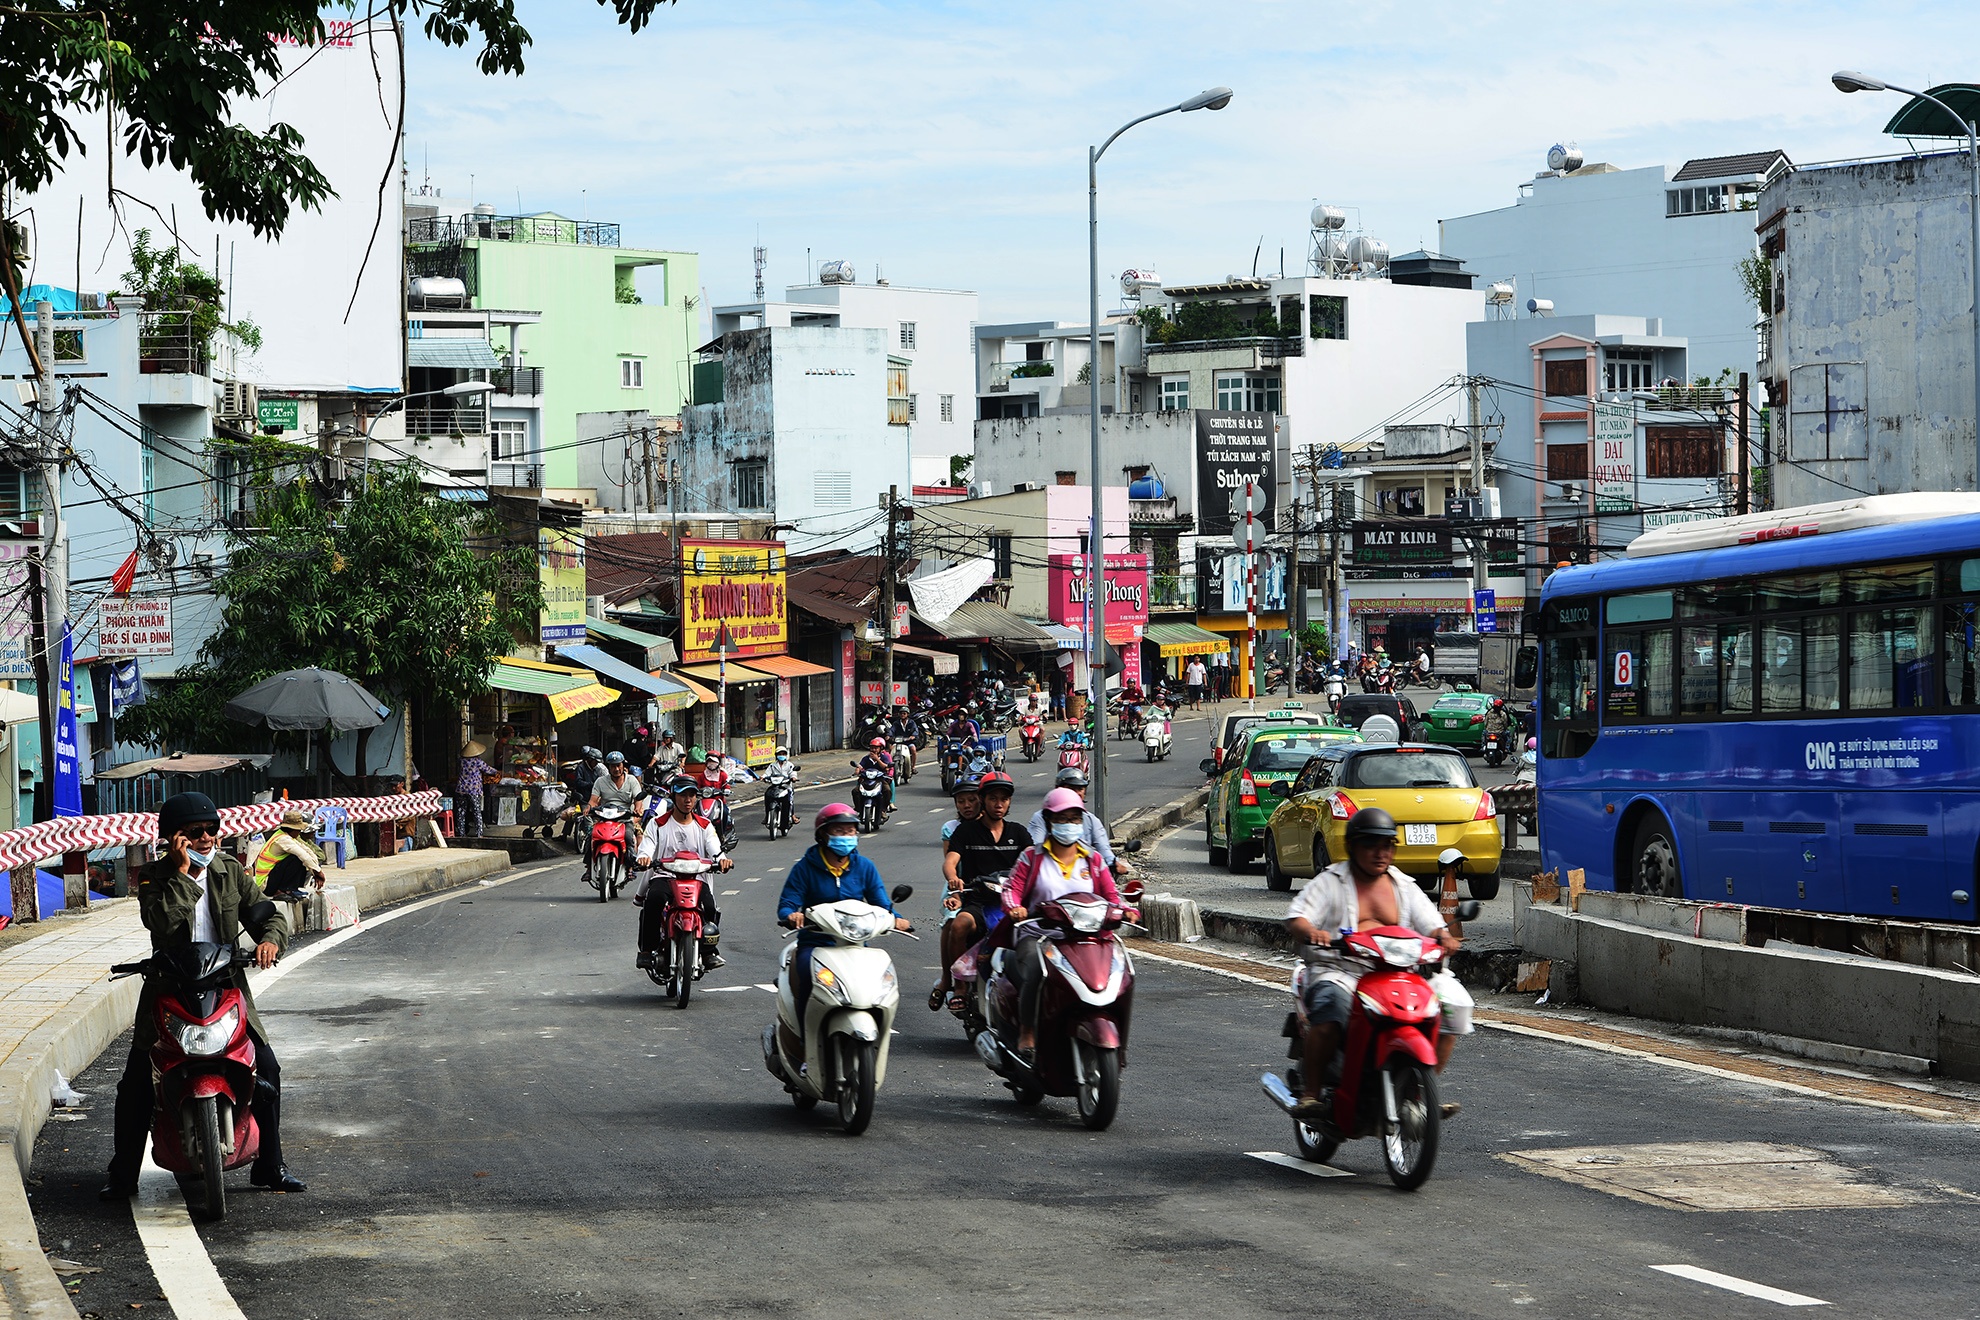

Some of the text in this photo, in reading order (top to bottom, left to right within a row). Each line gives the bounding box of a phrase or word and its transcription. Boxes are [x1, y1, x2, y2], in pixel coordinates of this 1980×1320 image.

[329, 21, 353, 46] 322
[1210, 416, 1263, 429] CHUYÊN SỈ & LẺ
[1600, 418, 1628, 431] TƯ NHÂN
[1210, 433, 1267, 445] THỜI TRANG NAM
[1207, 449, 1271, 462] TÚI XÁCH NAM NỮ
[1604, 441, 1623, 462] ĐẠI
[1356, 548, 1373, 561] 79
[702, 575, 745, 620] TRƯỜNG
[746, 572, 774, 617] PHÁT
[1104, 578, 1142, 611] Phong
[161, 602, 168, 610] 12
[139, 612, 165, 627] KHÁM
[1560, 607, 1589, 622] SAMCO
[101, 629, 171, 645] BÁC SĨ GIA ĐÌNH
[1618, 654, 1630, 683] 8
[895, 697, 906, 705] GA
[1806, 742, 1836, 770] CNG
[1412, 824, 1429, 833] 51G
[1408, 834, 1436, 844] 432.56
